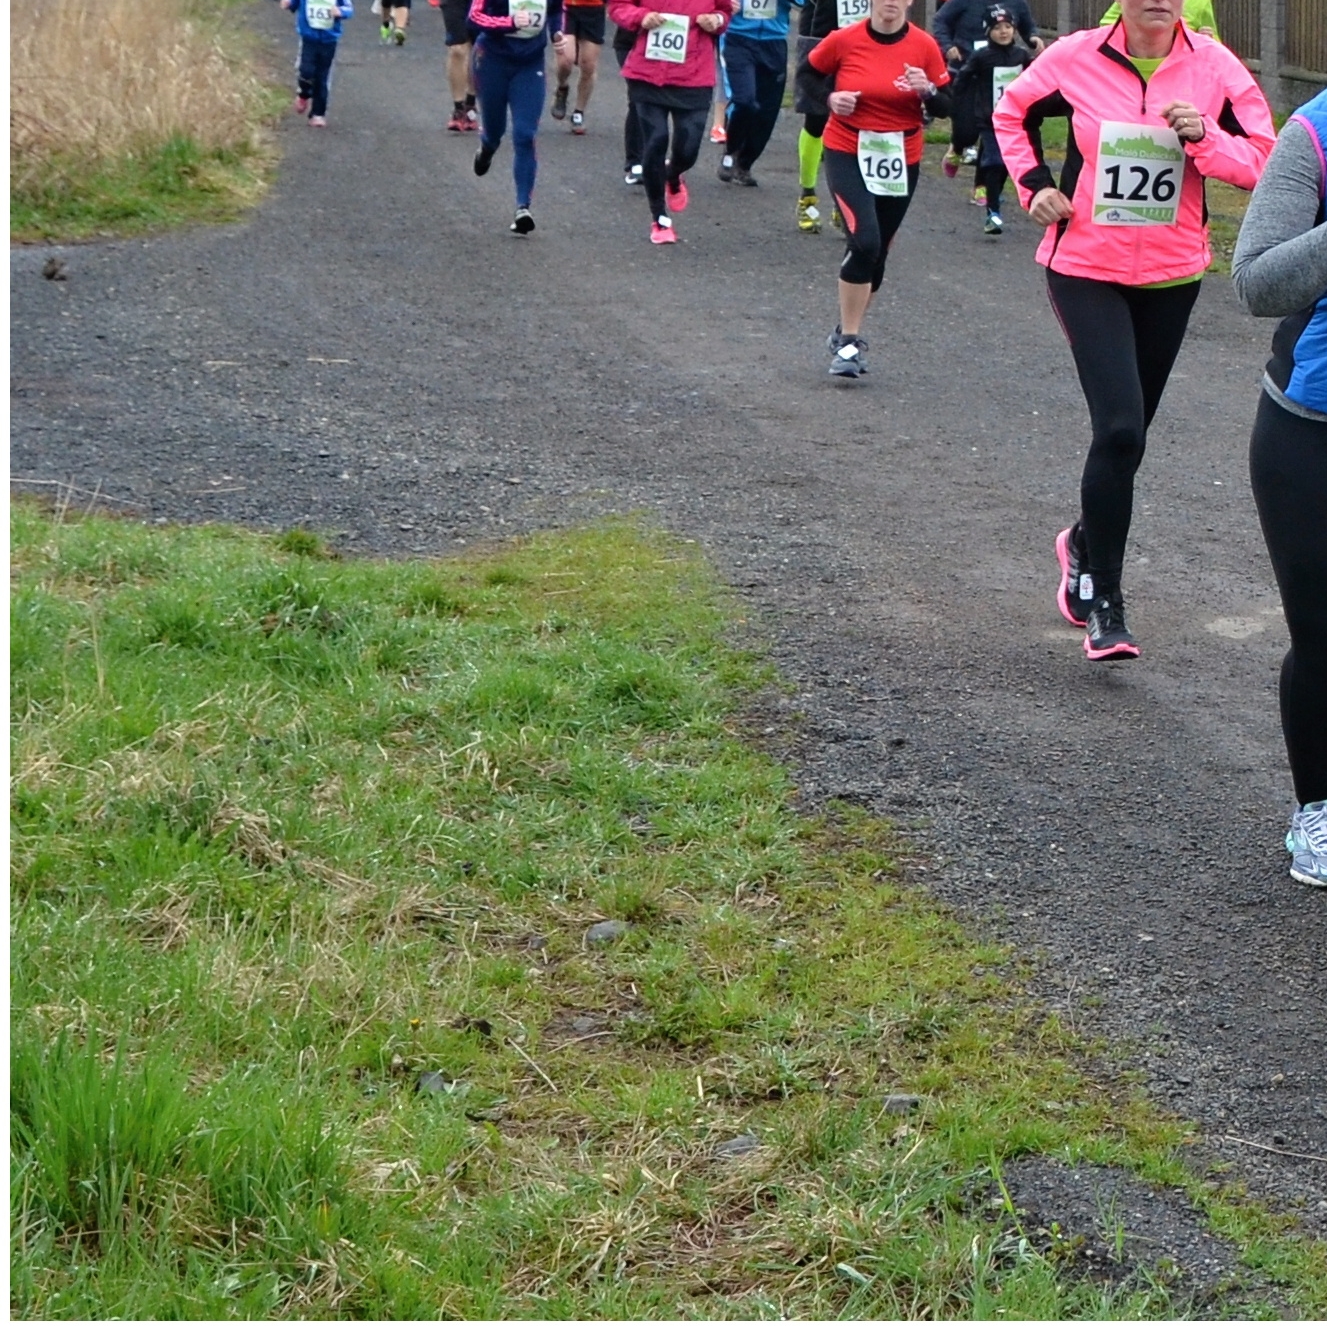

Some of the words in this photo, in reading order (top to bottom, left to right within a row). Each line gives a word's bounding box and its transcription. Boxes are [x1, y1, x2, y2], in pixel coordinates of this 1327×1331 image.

[651, 31, 685, 51] 160
[863, 155, 903, 180] 169
[1102, 164, 1176, 202] 126
